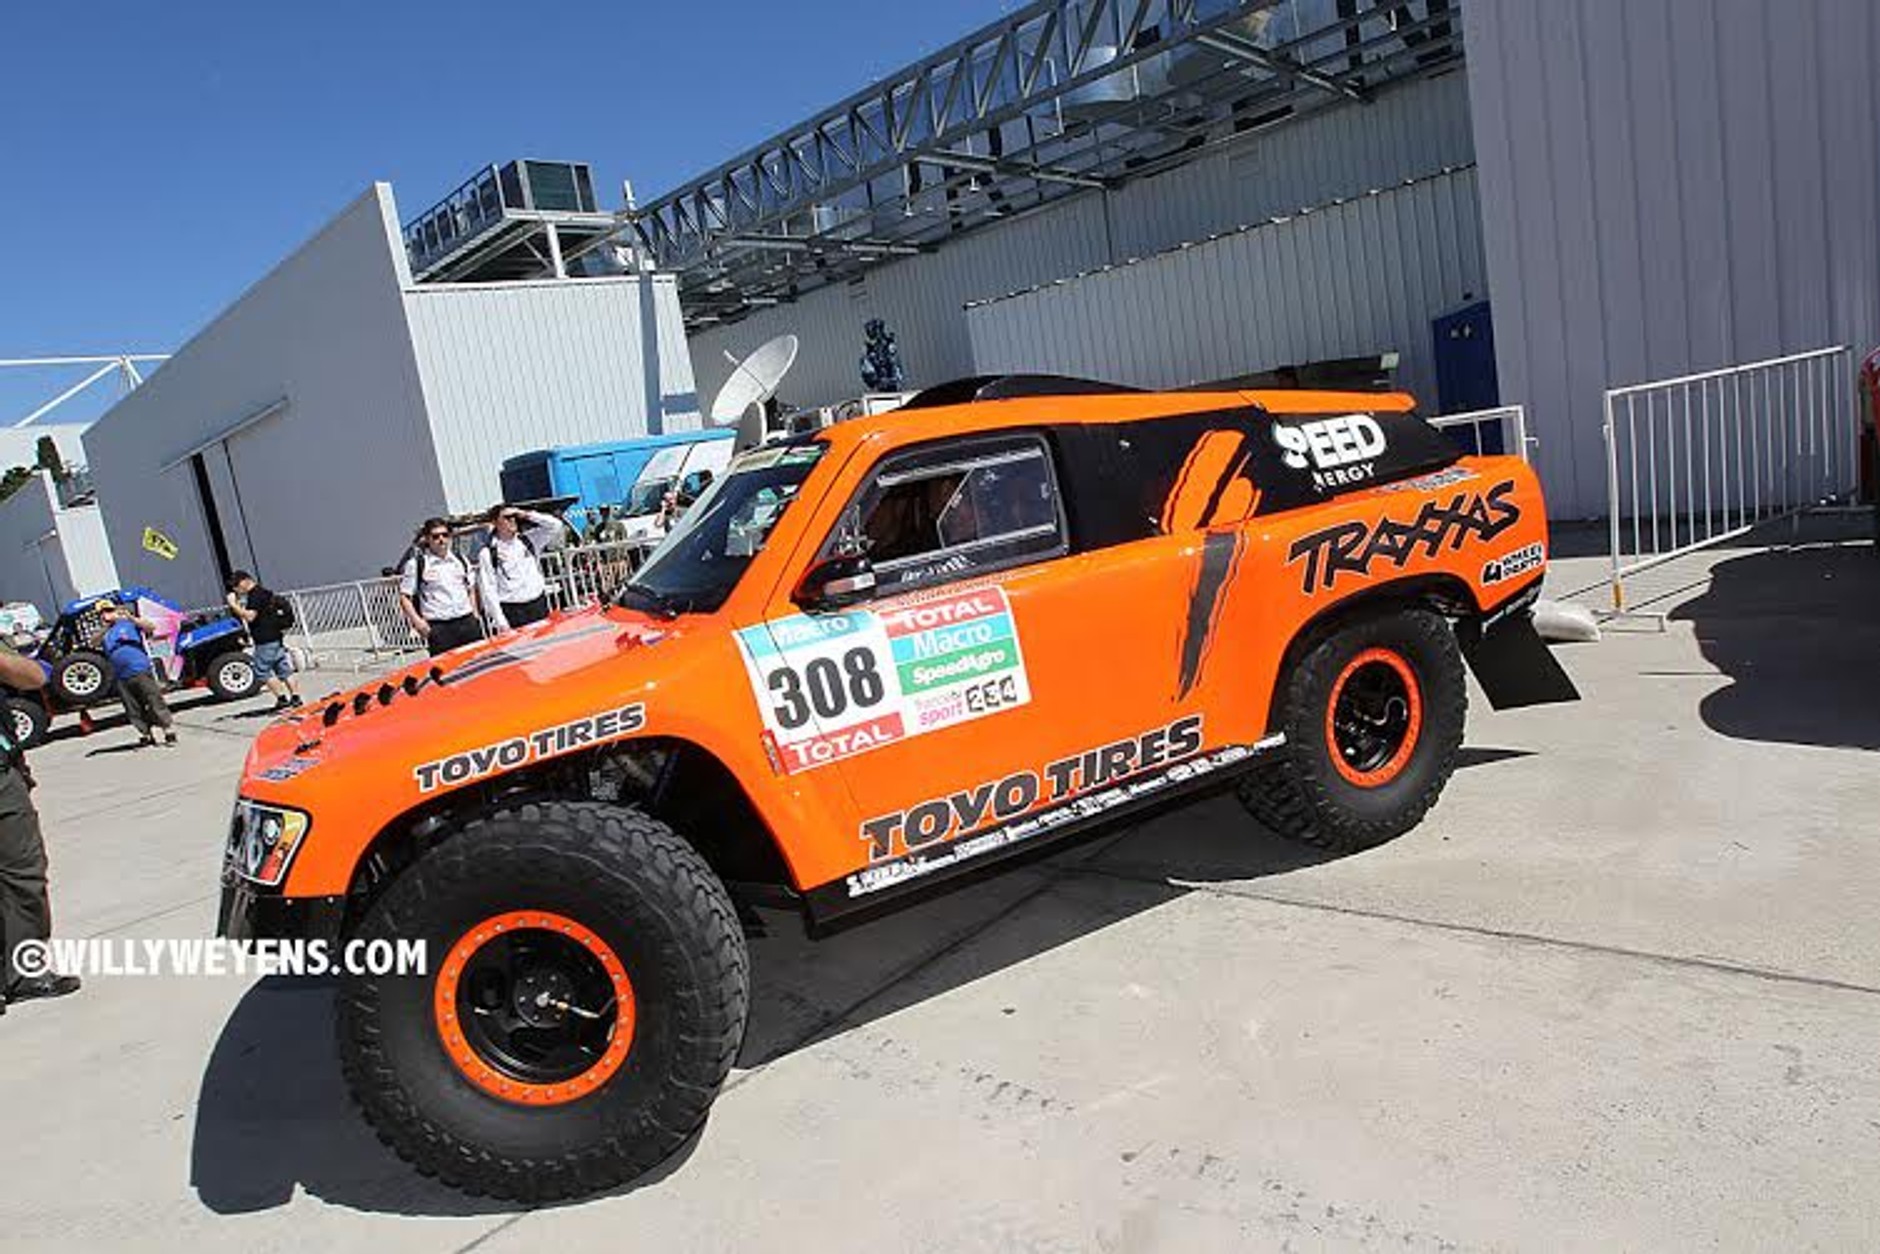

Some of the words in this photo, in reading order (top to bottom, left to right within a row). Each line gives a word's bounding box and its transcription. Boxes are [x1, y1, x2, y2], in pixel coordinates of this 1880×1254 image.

[1288, 479, 1520, 594] TRAXXAS
[1482, 561, 1502, 583] 4
[902, 598, 995, 630] TOTAL
[914, 622, 993, 660] Macro
[767, 646, 885, 730] 308
[912, 649, 1006, 686] SpeedAgro
[414, 738, 530, 791] TOYO
[530, 703, 645, 757] TIRES
[789, 724, 892, 767] TOTAL
[860, 771, 1040, 861] TOYO
[1045, 714, 1204, 800] TIRES
